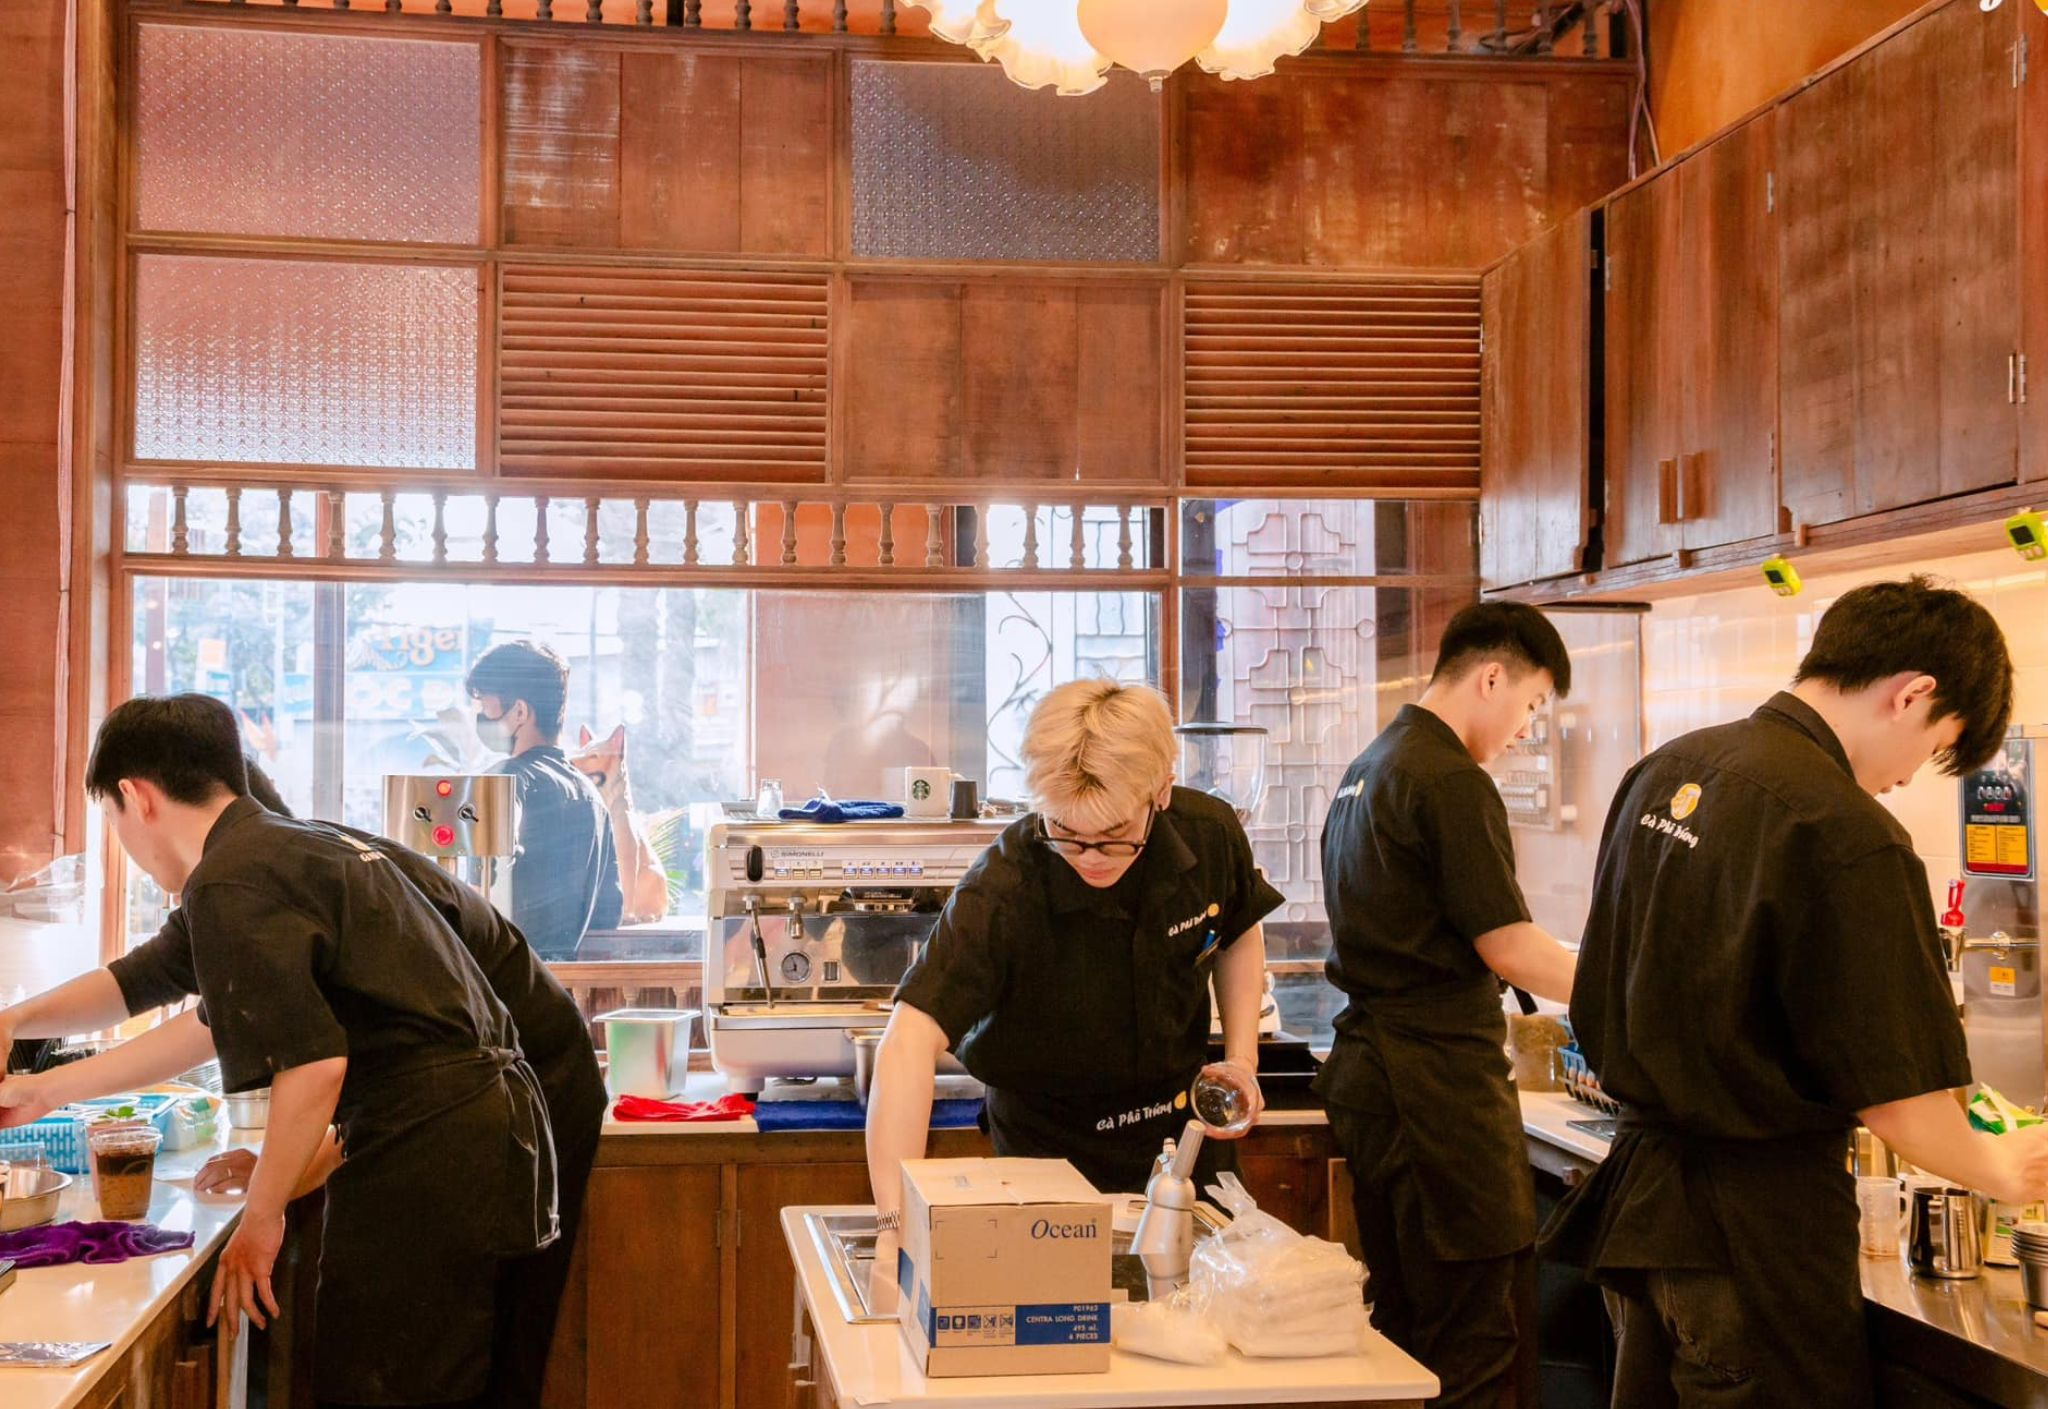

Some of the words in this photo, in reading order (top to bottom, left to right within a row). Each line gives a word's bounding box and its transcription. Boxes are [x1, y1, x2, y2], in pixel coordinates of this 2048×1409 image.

[1096, 1116, 1115, 1131] Cà
[1031, 1219, 1096, 1240] Ocean
[1026, 1315, 1053, 1324] CENTRA
[1055, 1314, 1075, 1323] LONG
[1077, 1313, 1098, 1322] DRINK
[1076, 1332, 1098, 1341] PIECES
